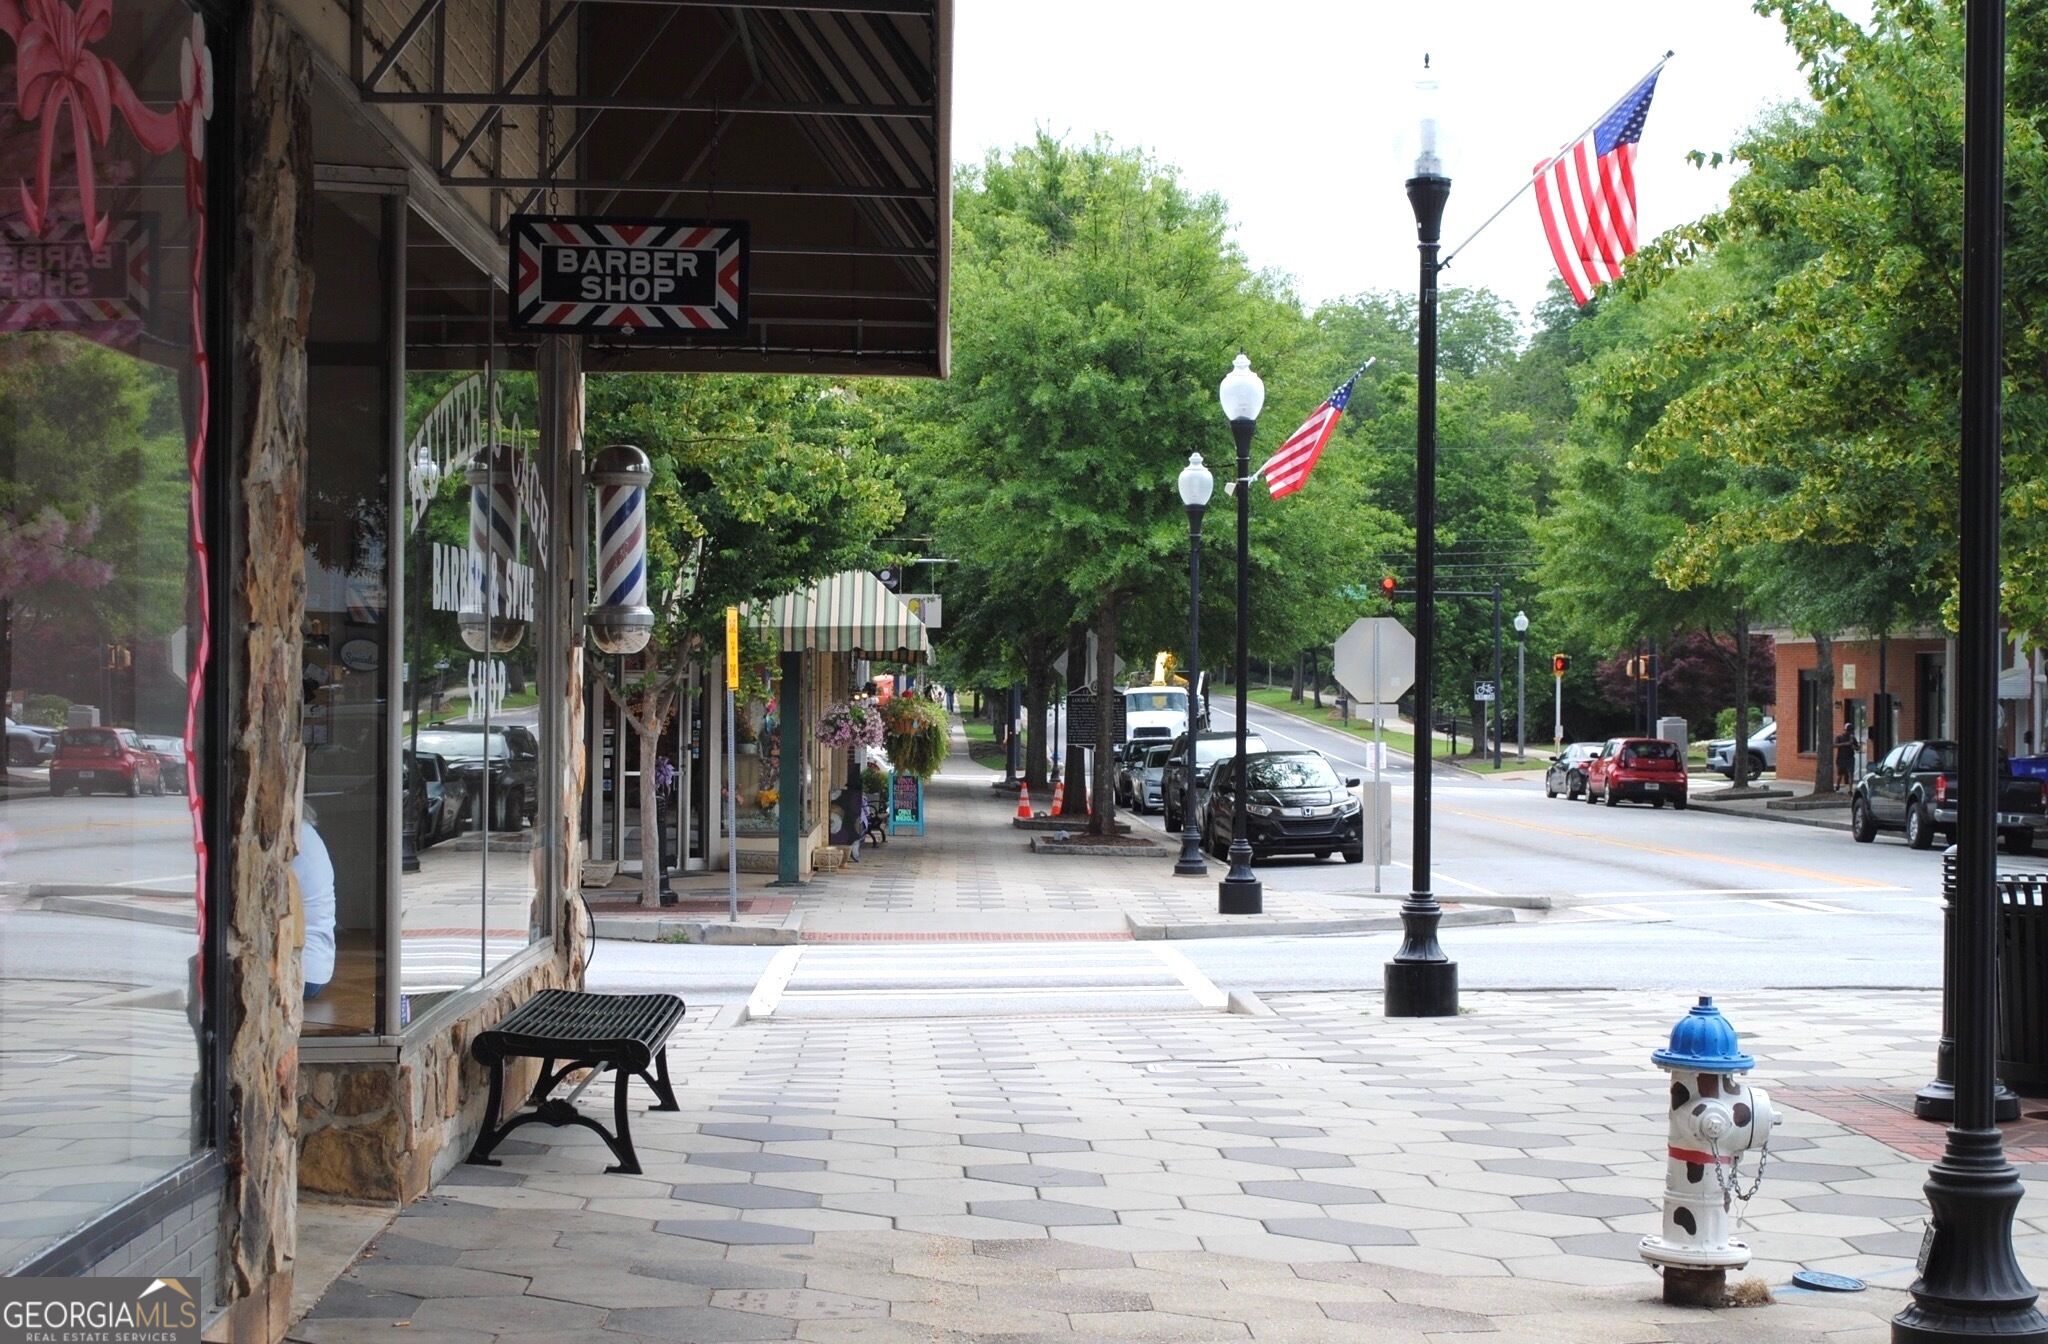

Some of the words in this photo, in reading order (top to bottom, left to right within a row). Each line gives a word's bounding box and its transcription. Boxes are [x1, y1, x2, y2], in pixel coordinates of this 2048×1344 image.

[557, 248, 698, 277] BARBER
[581, 276, 676, 302] SHOP
[511, 412, 549, 572] CAGE
[432, 542, 483, 614] BARBER
[490, 551, 500, 617] &
[506, 558, 534, 622] STYLE
[467, 658, 507, 722] SHOP
